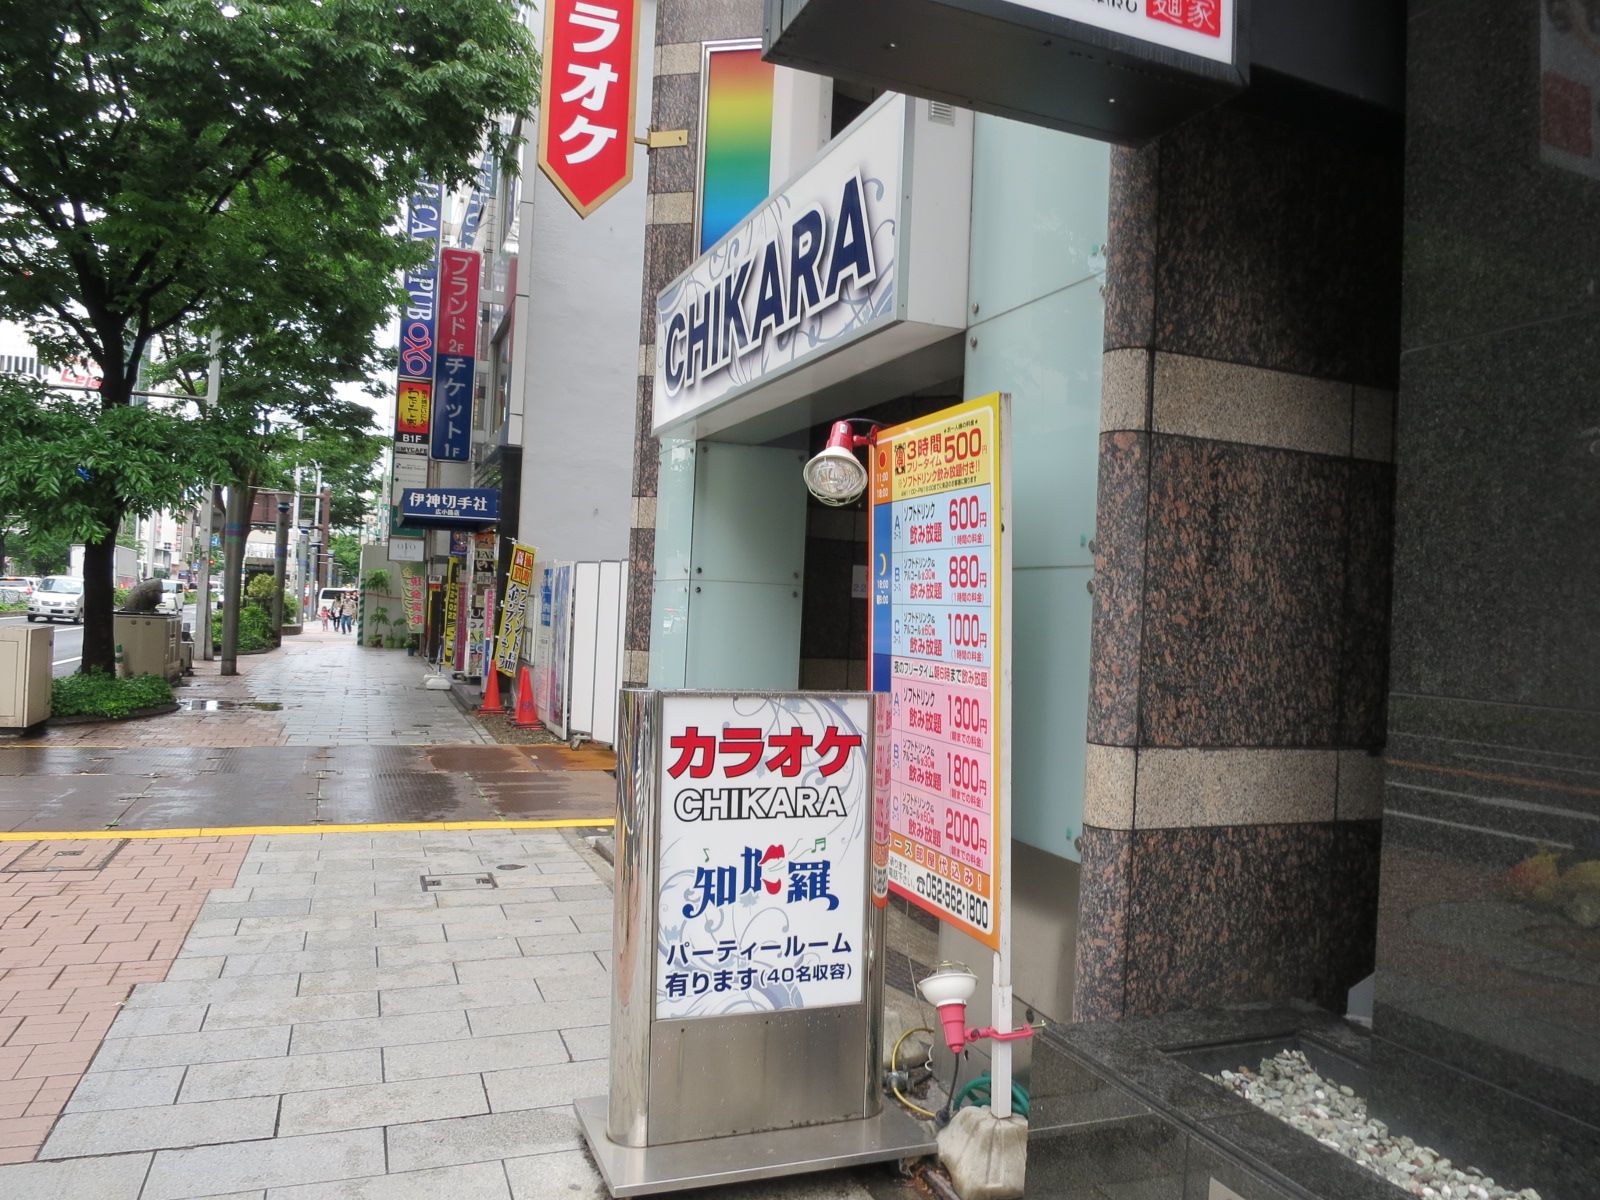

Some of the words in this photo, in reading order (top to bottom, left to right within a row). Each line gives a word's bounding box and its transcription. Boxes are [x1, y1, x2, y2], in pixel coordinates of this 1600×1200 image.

[559, 2, 620, 164] ラオケ
[406, 277, 434, 320] PUB
[664, 167, 876, 397] CHIKARA
[448, 340, 465, 353] 2F
[444, 357, 467, 440] チケット
[402, 434, 422, 443] B1F
[444, 443, 460, 458] 1F
[907, 433, 942, 460] 3時間
[409, 492, 488, 511] 伊神切手社
[949, 495, 987, 531] 600円
[910, 522, 942, 544] 飲み放題
[949, 555, 987, 589] 880円
[910, 582, 943, 599] 飲み放題
[910, 637, 943, 656] 飲み放題
[947, 613, 987, 649] 1000円
[909, 707, 942, 734] 飲み放題
[947, 694, 987, 734] 1300円
[667, 726, 862, 779] カラオケ
[909, 764, 942, 791] 飲み放題
[947, 752, 987, 796] 1800円
[674, 786, 848, 822] CHIKARA
[908, 818, 942, 848] 飲み放題
[946, 807, 988, 856] 2000円
[889, 833, 982, 891] ース部屋代込み!
[666, 932, 852, 966] パーティールーム
[665, 963, 852, 998] 有ります(40名収容)
